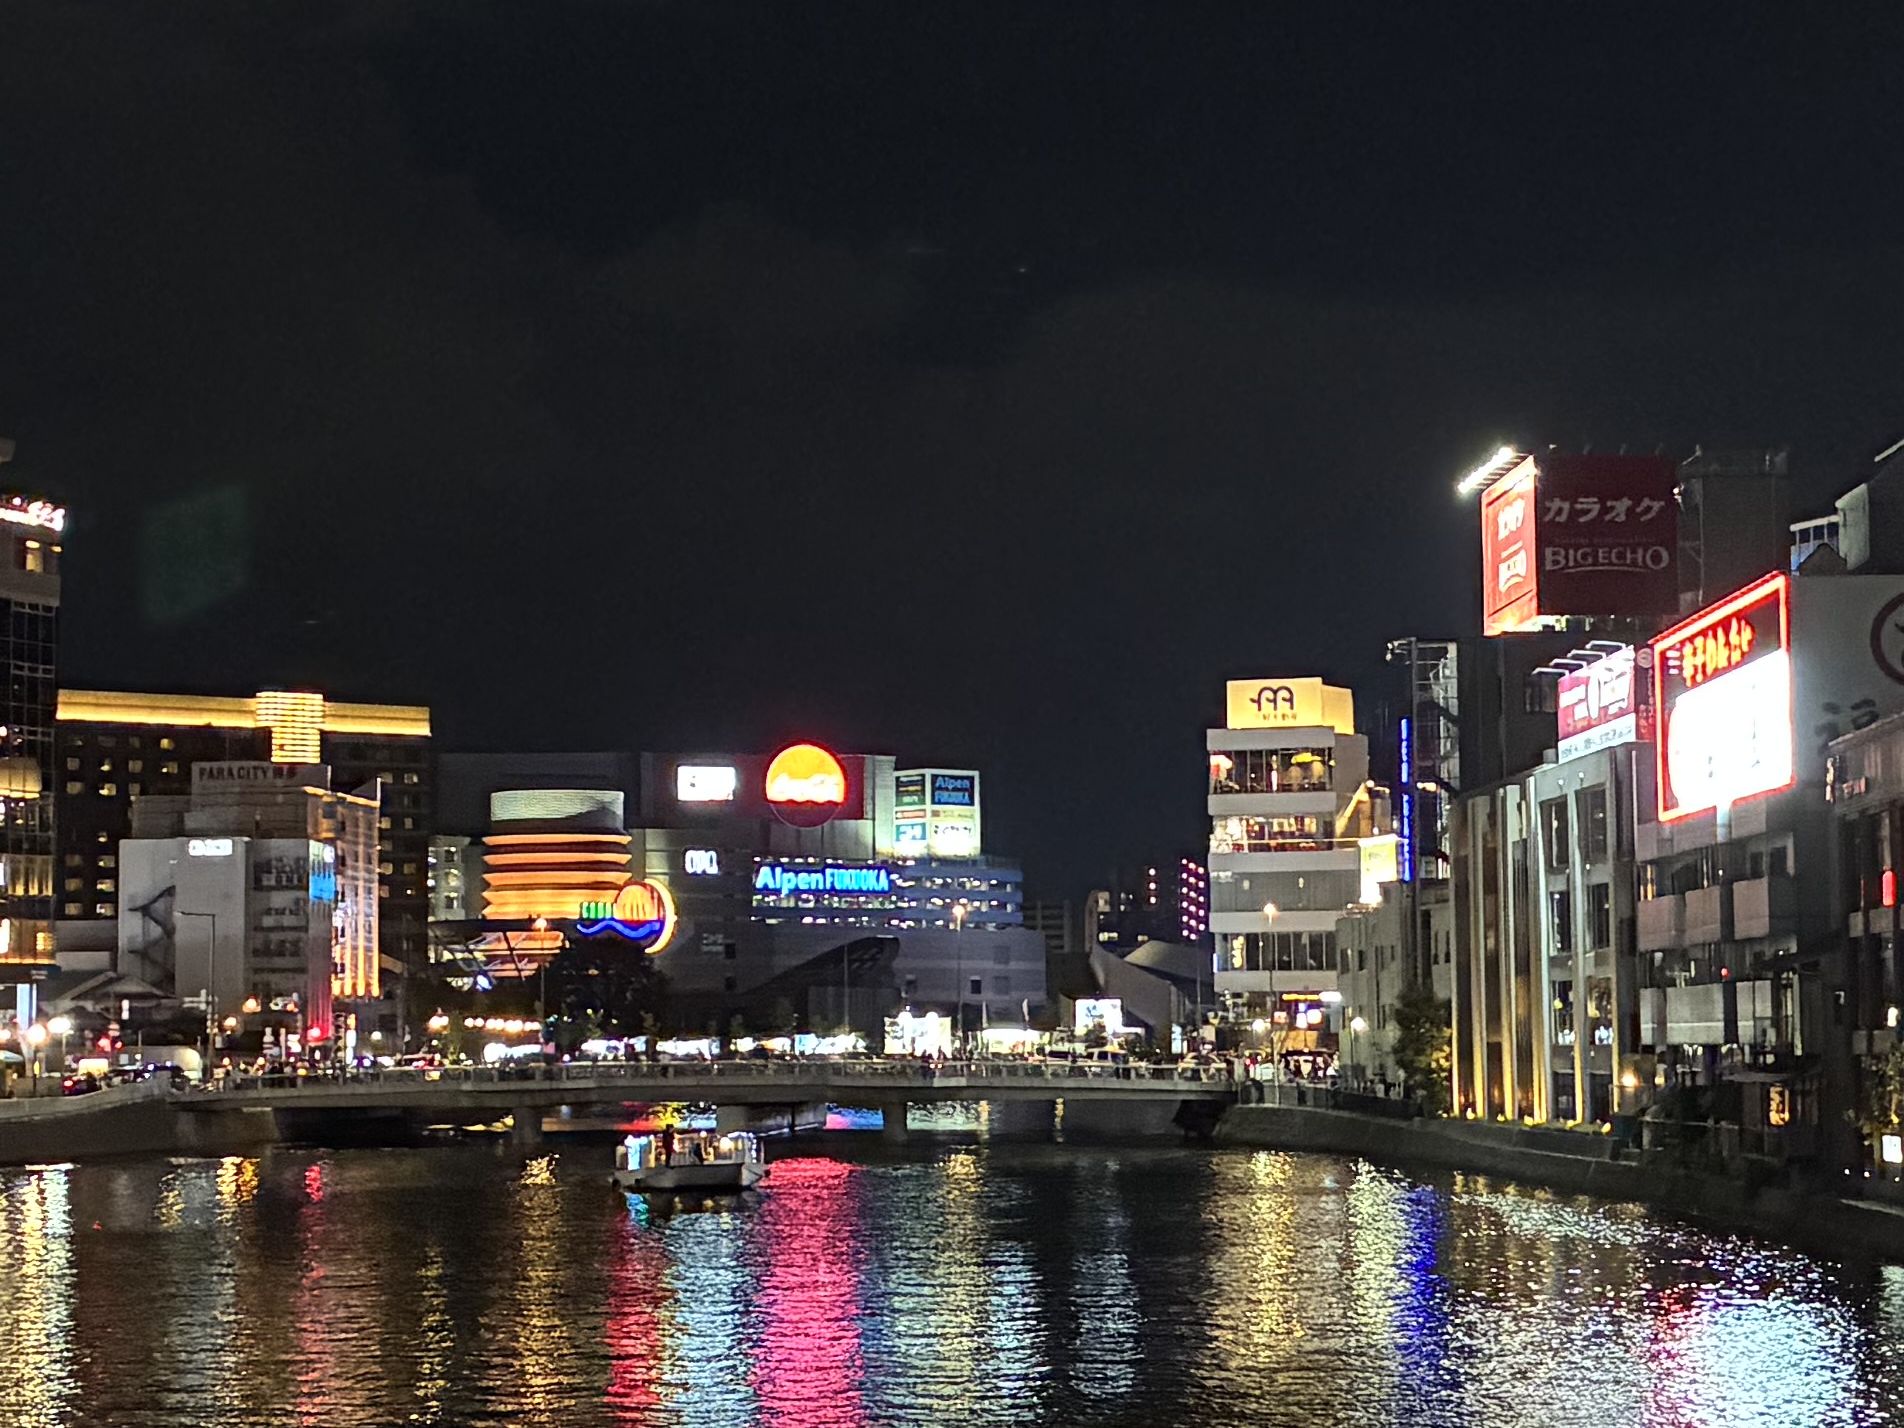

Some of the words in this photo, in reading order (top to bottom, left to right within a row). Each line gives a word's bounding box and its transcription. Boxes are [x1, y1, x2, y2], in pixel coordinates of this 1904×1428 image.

[1544, 497, 1666, 523] カラオケ
[1545, 546, 1593, 571] BIG
[1597, 545, 1670, 571] ECHO
[755, 865, 825, 898] Alpen
[825, 867, 890, 892] FUKUOKA
